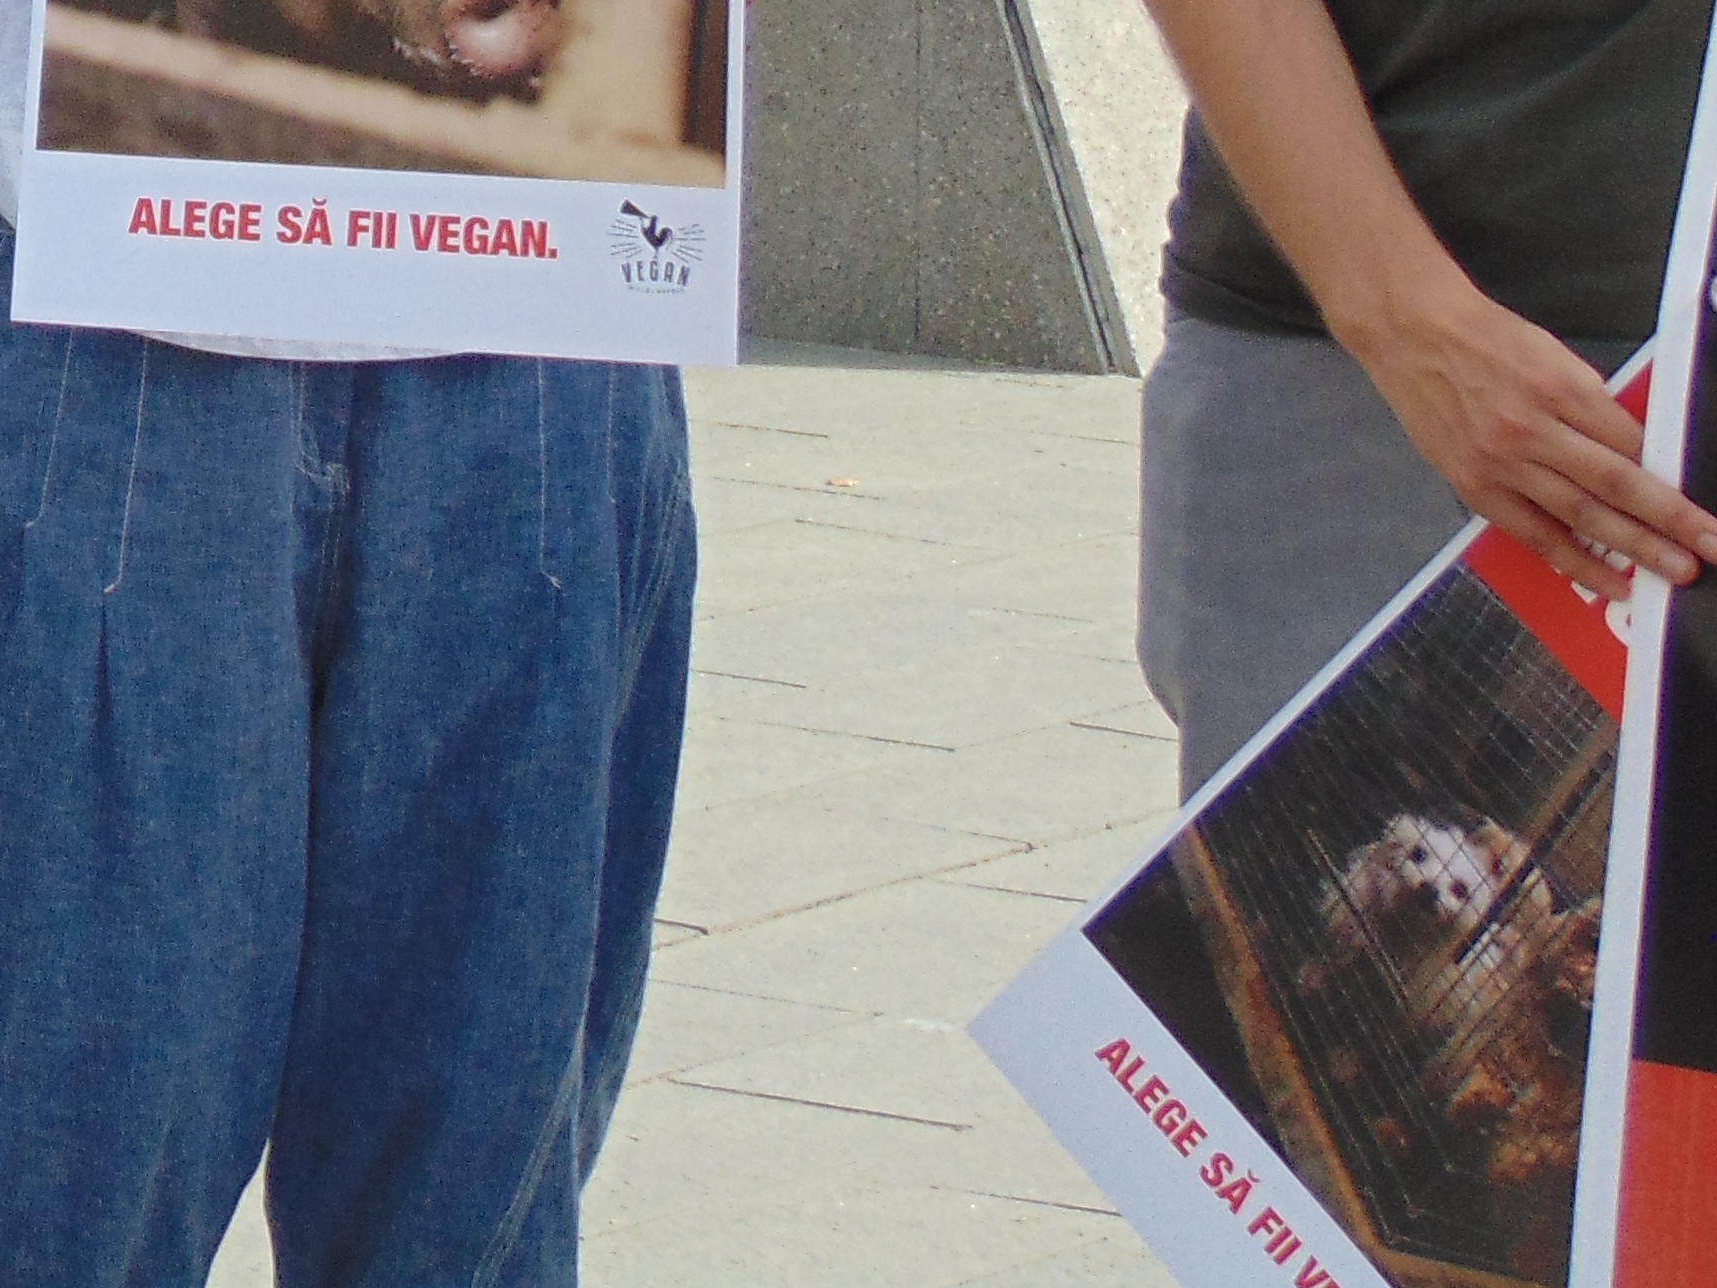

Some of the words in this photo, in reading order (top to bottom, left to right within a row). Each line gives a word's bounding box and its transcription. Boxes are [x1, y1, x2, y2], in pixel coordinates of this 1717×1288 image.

[128, 197, 263, 242] ALEGE
[275, 198, 333, 246] SĂ
[348, 208, 397, 250] FII
[408, 213, 559, 261] VEGAN.
[621, 260, 691, 287] VEGAN
[1094, 1037, 1209, 1159] ALEGE
[1199, 1152, 1260, 1215] SĂ
[1246, 1206, 1302, 1265] FII
